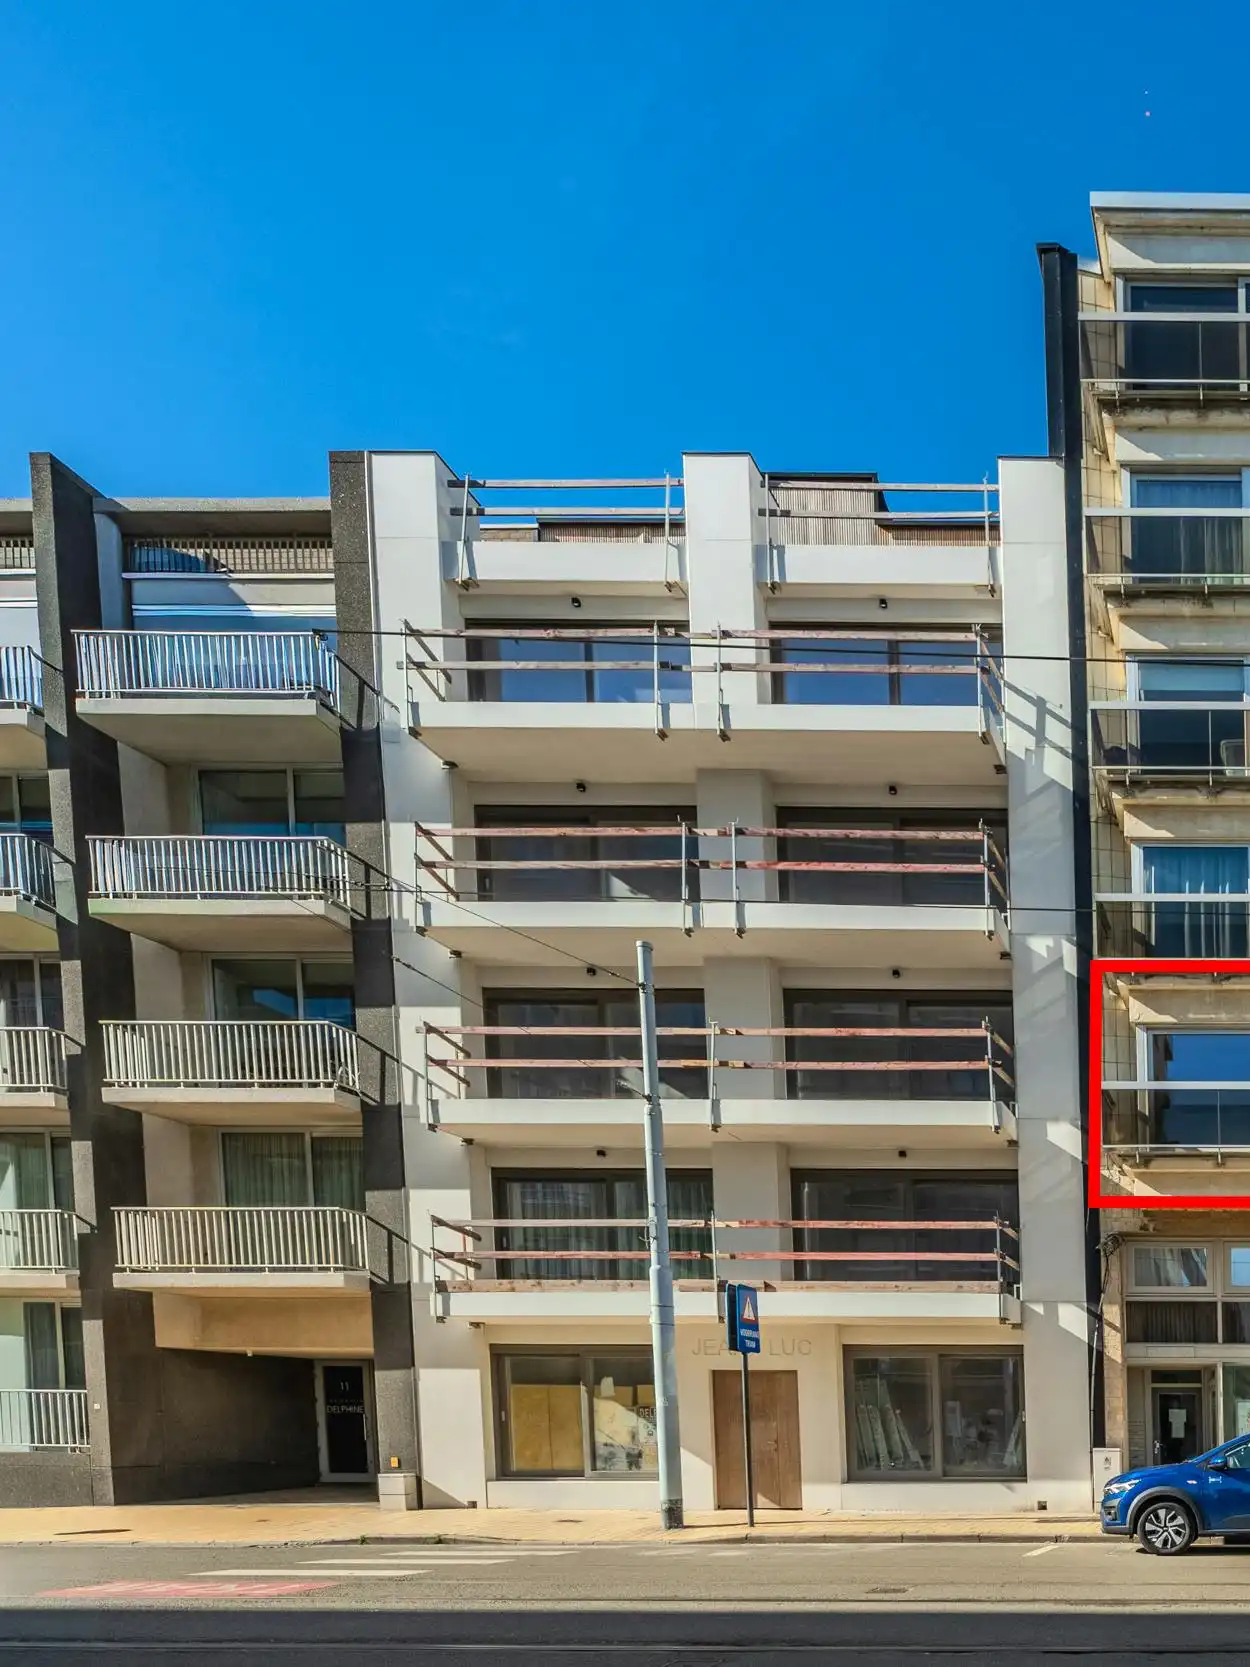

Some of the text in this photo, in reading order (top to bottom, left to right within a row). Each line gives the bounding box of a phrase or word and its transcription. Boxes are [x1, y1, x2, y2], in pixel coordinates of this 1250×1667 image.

[692, 1338, 812, 1355] JEA LUC
[326, 1405, 365, 1414] DELPHINE
